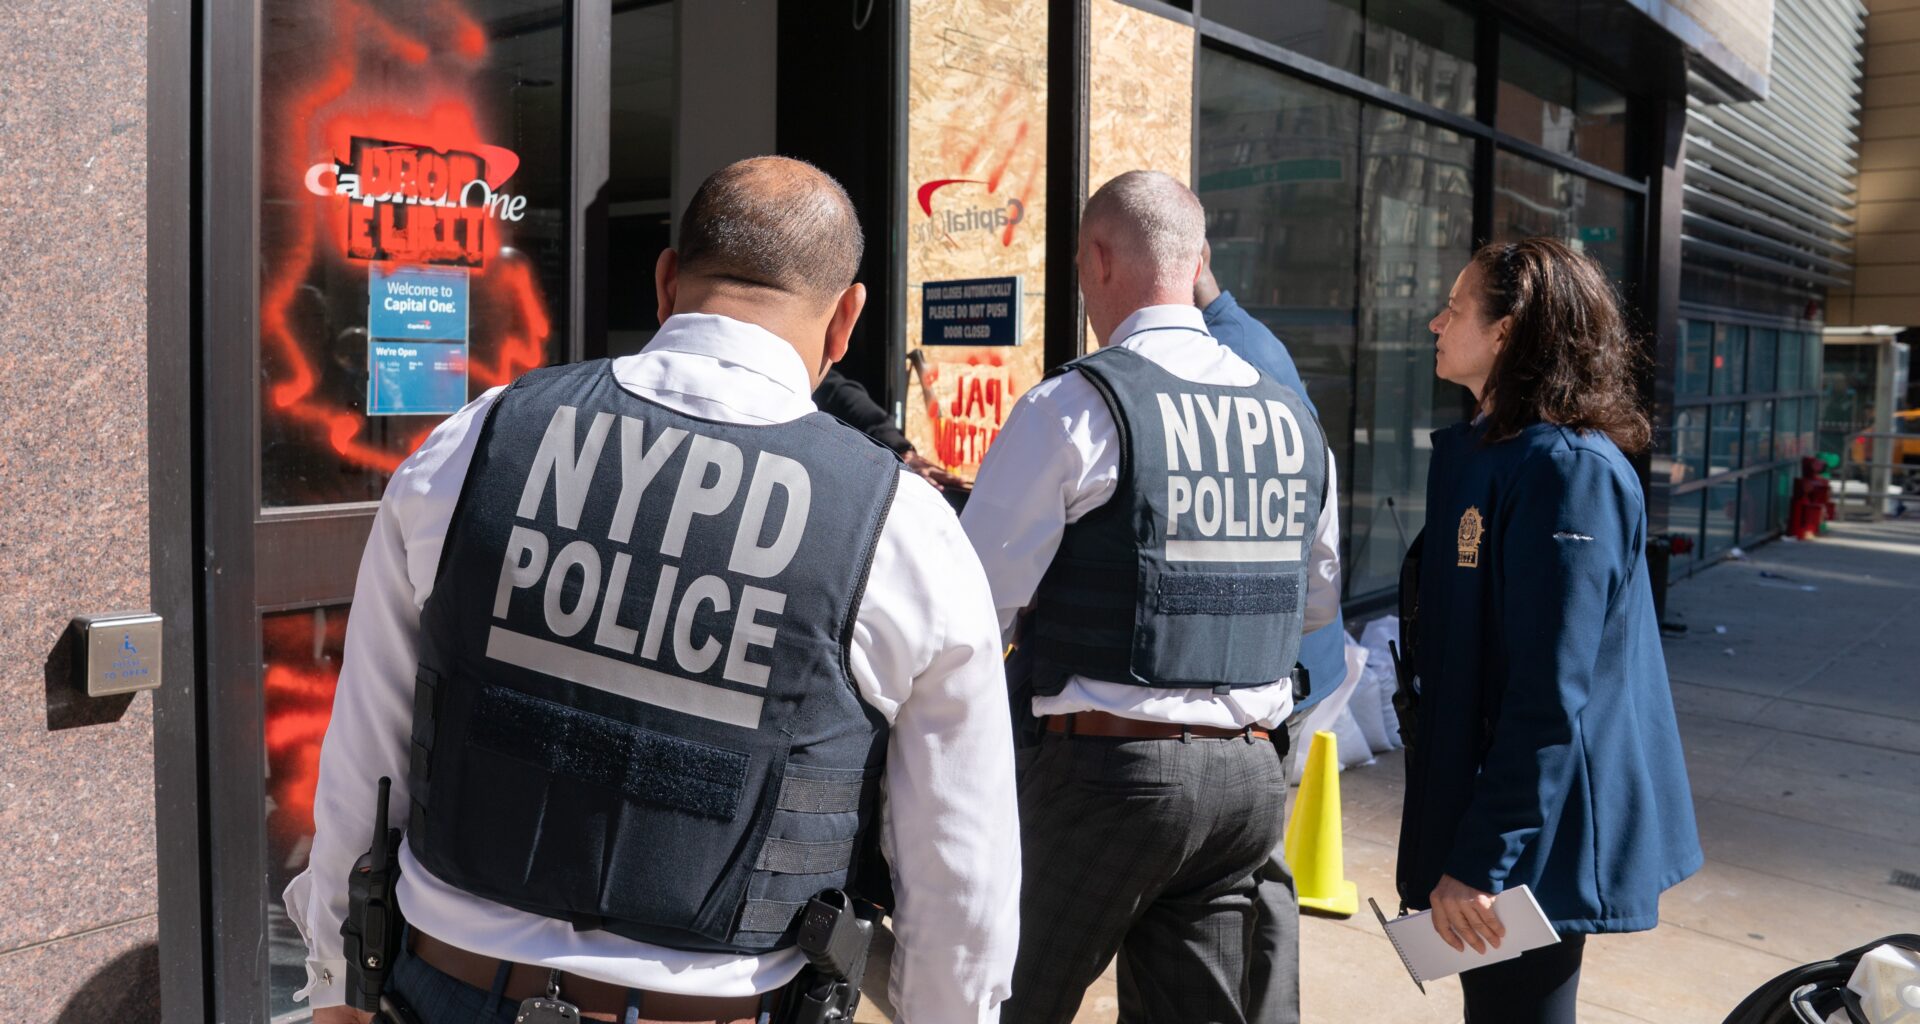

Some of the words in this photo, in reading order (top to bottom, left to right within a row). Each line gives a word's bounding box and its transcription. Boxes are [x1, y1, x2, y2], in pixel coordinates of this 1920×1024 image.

[387, 282, 439, 297] Welcome
[441, 286, 453, 298] to
[926, 287, 941, 300] DOOR
[942, 286, 962, 299] CLOSES
[963, 283, 1012, 298] AUTOMATICALLY
[384, 297, 427, 314] Capital
[929, 304, 956, 319] PLEASE
[956, 304, 968, 318] DO
[969, 304, 986, 318] NOT
[986, 302, 1008, 317] PUSH
[943, 326, 963, 339] DOOR
[963, 324, 991, 338] CLOSED
[376, 347, 397, 356] We're
[398, 347, 418, 358] Open
[1156, 393, 1305, 475] NYPD
[516, 405, 812, 579] NYPD
[1166, 476, 1307, 537] POLICE
[492, 525, 788, 689] POLICE
